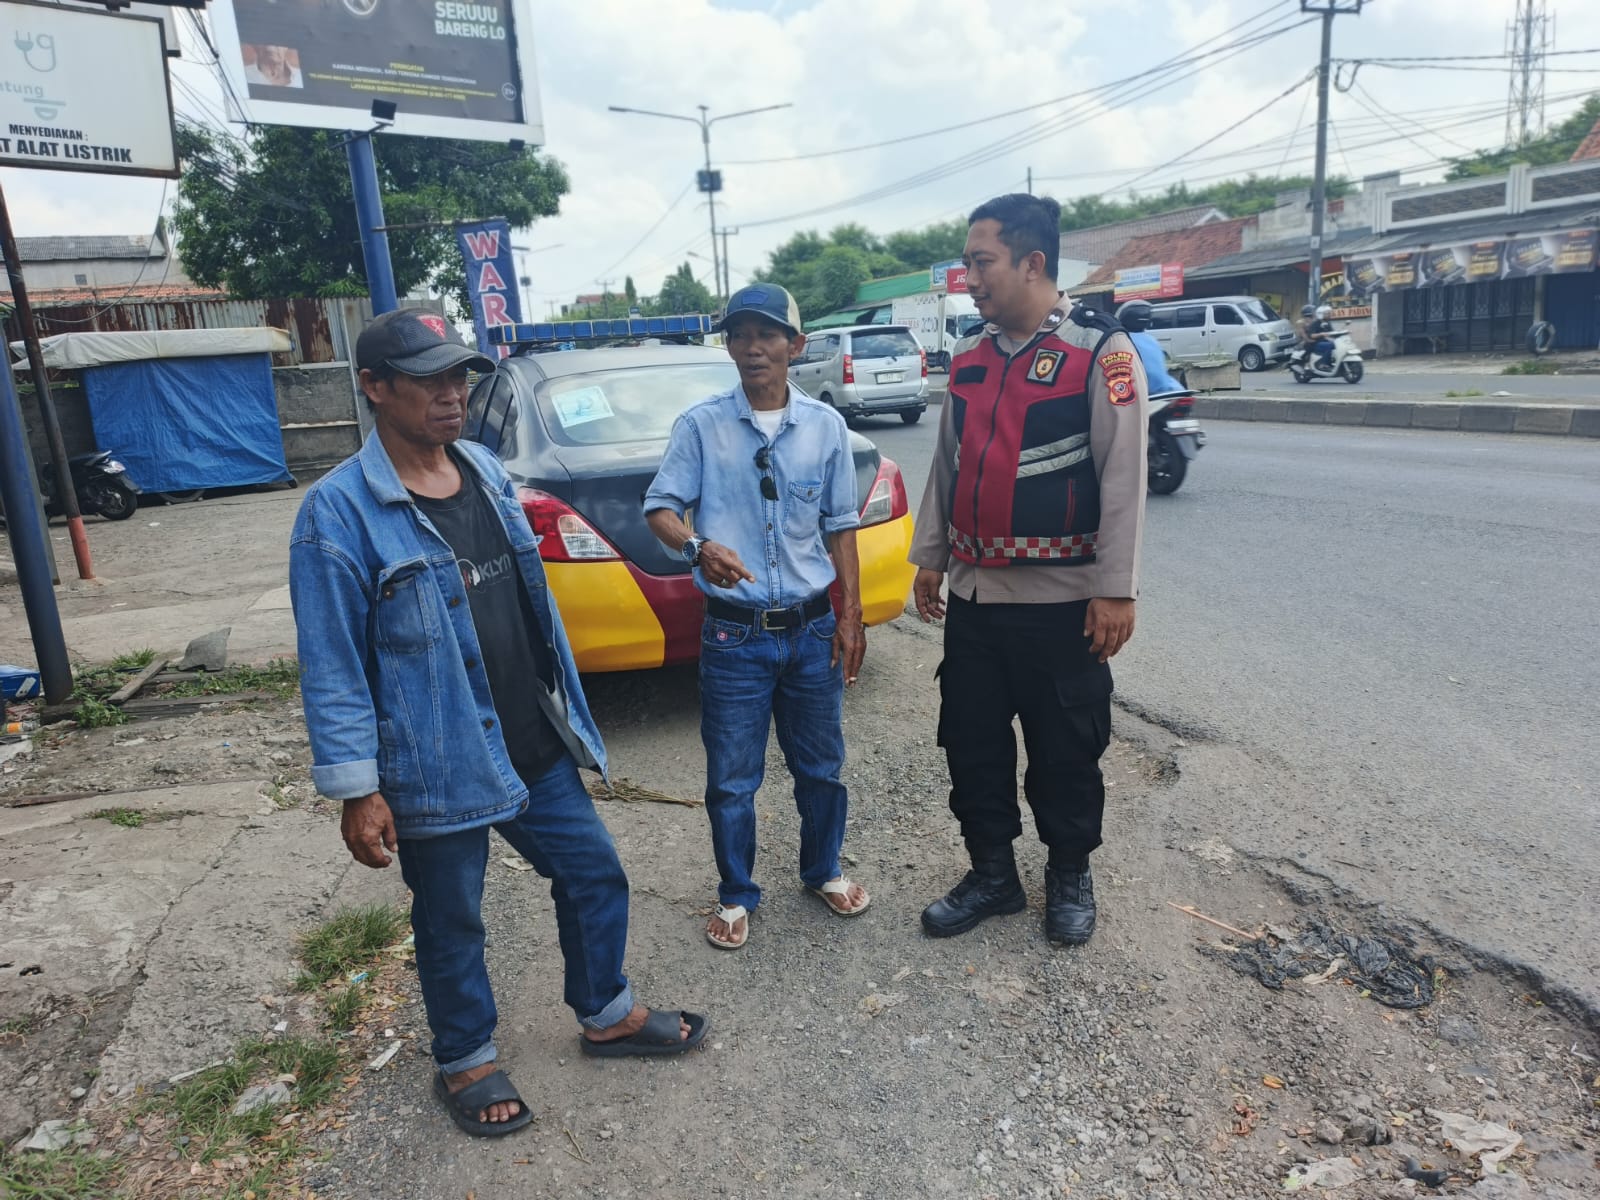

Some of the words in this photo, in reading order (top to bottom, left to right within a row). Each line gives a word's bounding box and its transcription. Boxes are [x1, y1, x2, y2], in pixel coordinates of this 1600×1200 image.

[435, 1, 498, 23] SERUUU
[435, 20, 488, 39] BARENG
[489, 25, 506, 40] LO
[17, 139, 59, 158] ALAT
[64, 143, 132, 163] LISTRIK
